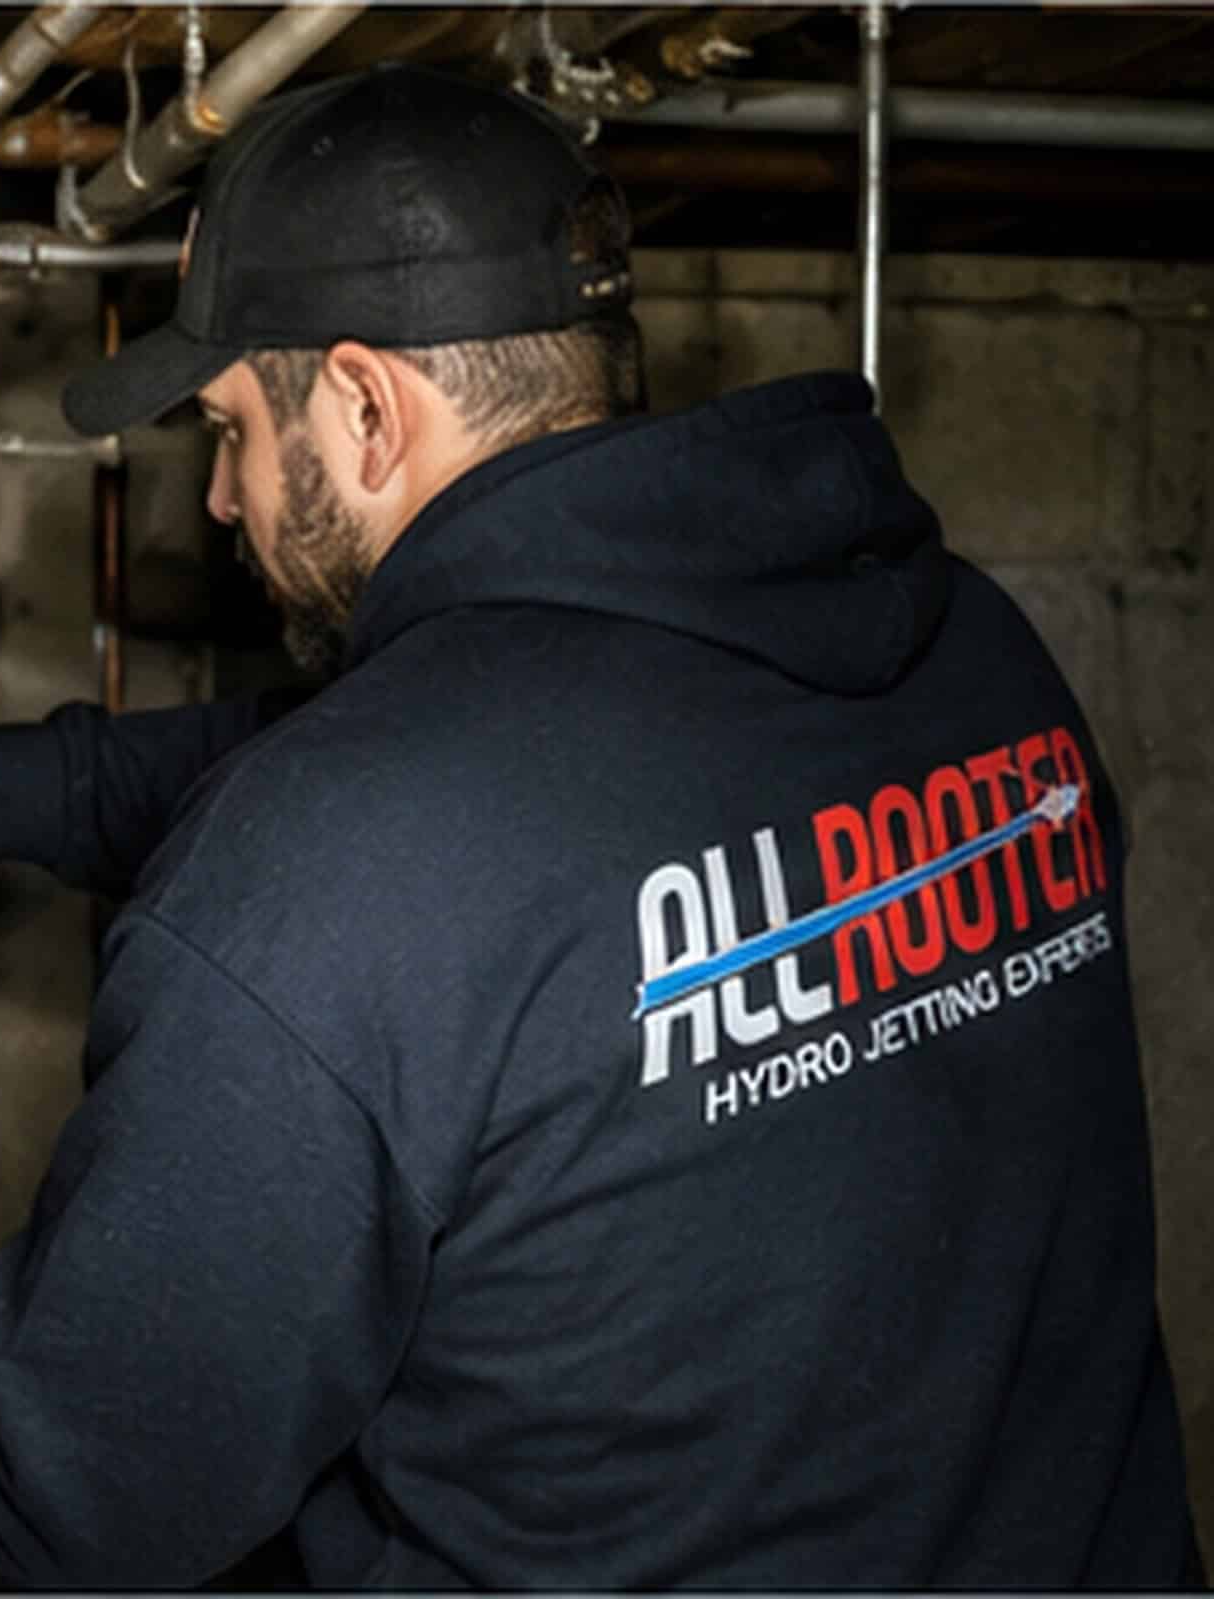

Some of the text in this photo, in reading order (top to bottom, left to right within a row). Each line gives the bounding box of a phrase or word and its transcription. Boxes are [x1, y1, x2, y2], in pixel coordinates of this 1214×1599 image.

[637, 727, 1107, 1087] ALL ROOTER
[705, 1031, 852, 1125] HYDRO
[862, 969, 1001, 1062] JETTING
